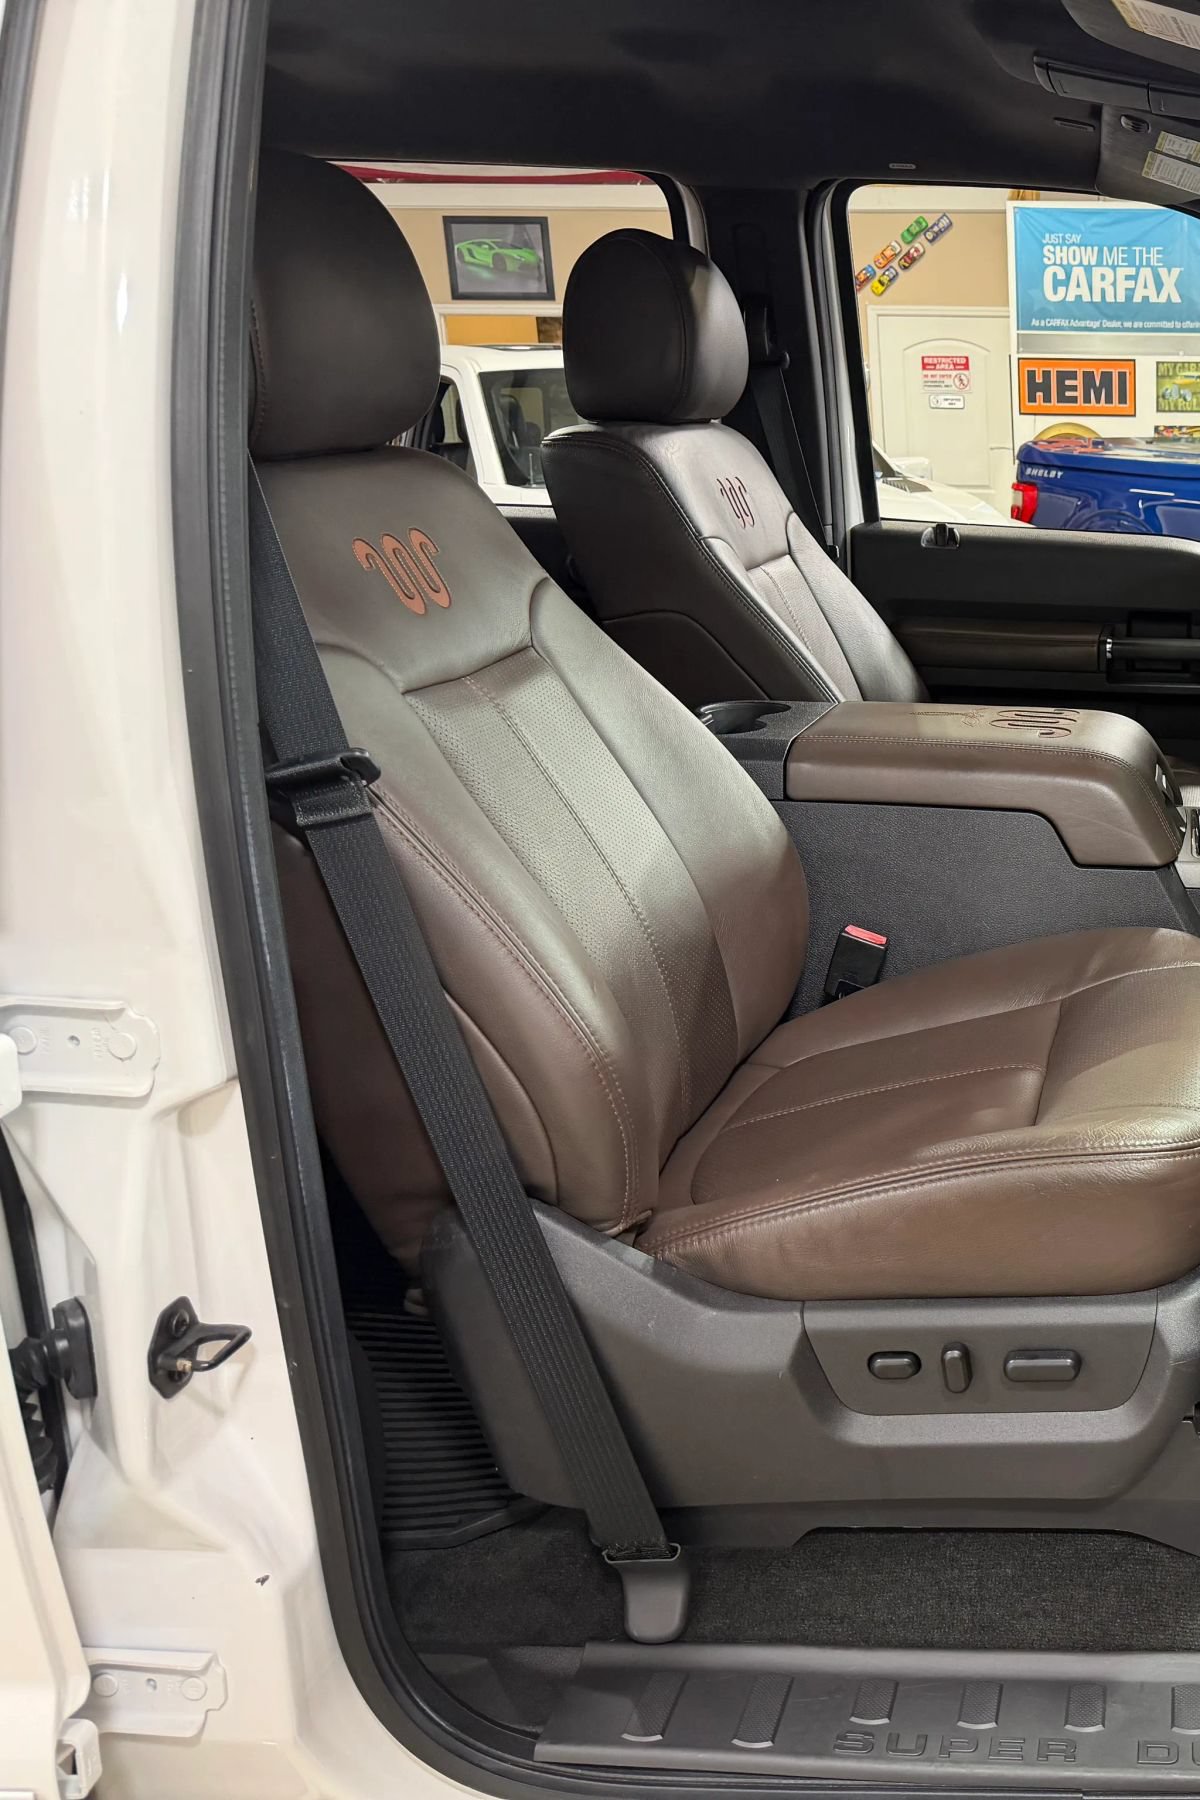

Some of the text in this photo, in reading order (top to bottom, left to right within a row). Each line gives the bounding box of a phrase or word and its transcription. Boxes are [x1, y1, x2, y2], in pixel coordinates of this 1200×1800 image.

[1042, 233, 1081, 243] JUST SAY
[1043, 245, 1163, 265] SHOW ME THE
[1043, 266, 1182, 303] CARFAX
[1158, 363, 1175, 376] MY
[1025, 368, 1129, 406] HEMI
[1025, 467, 1063, 479] SHELBY
[832, 1731, 1077, 1763] SUPER
